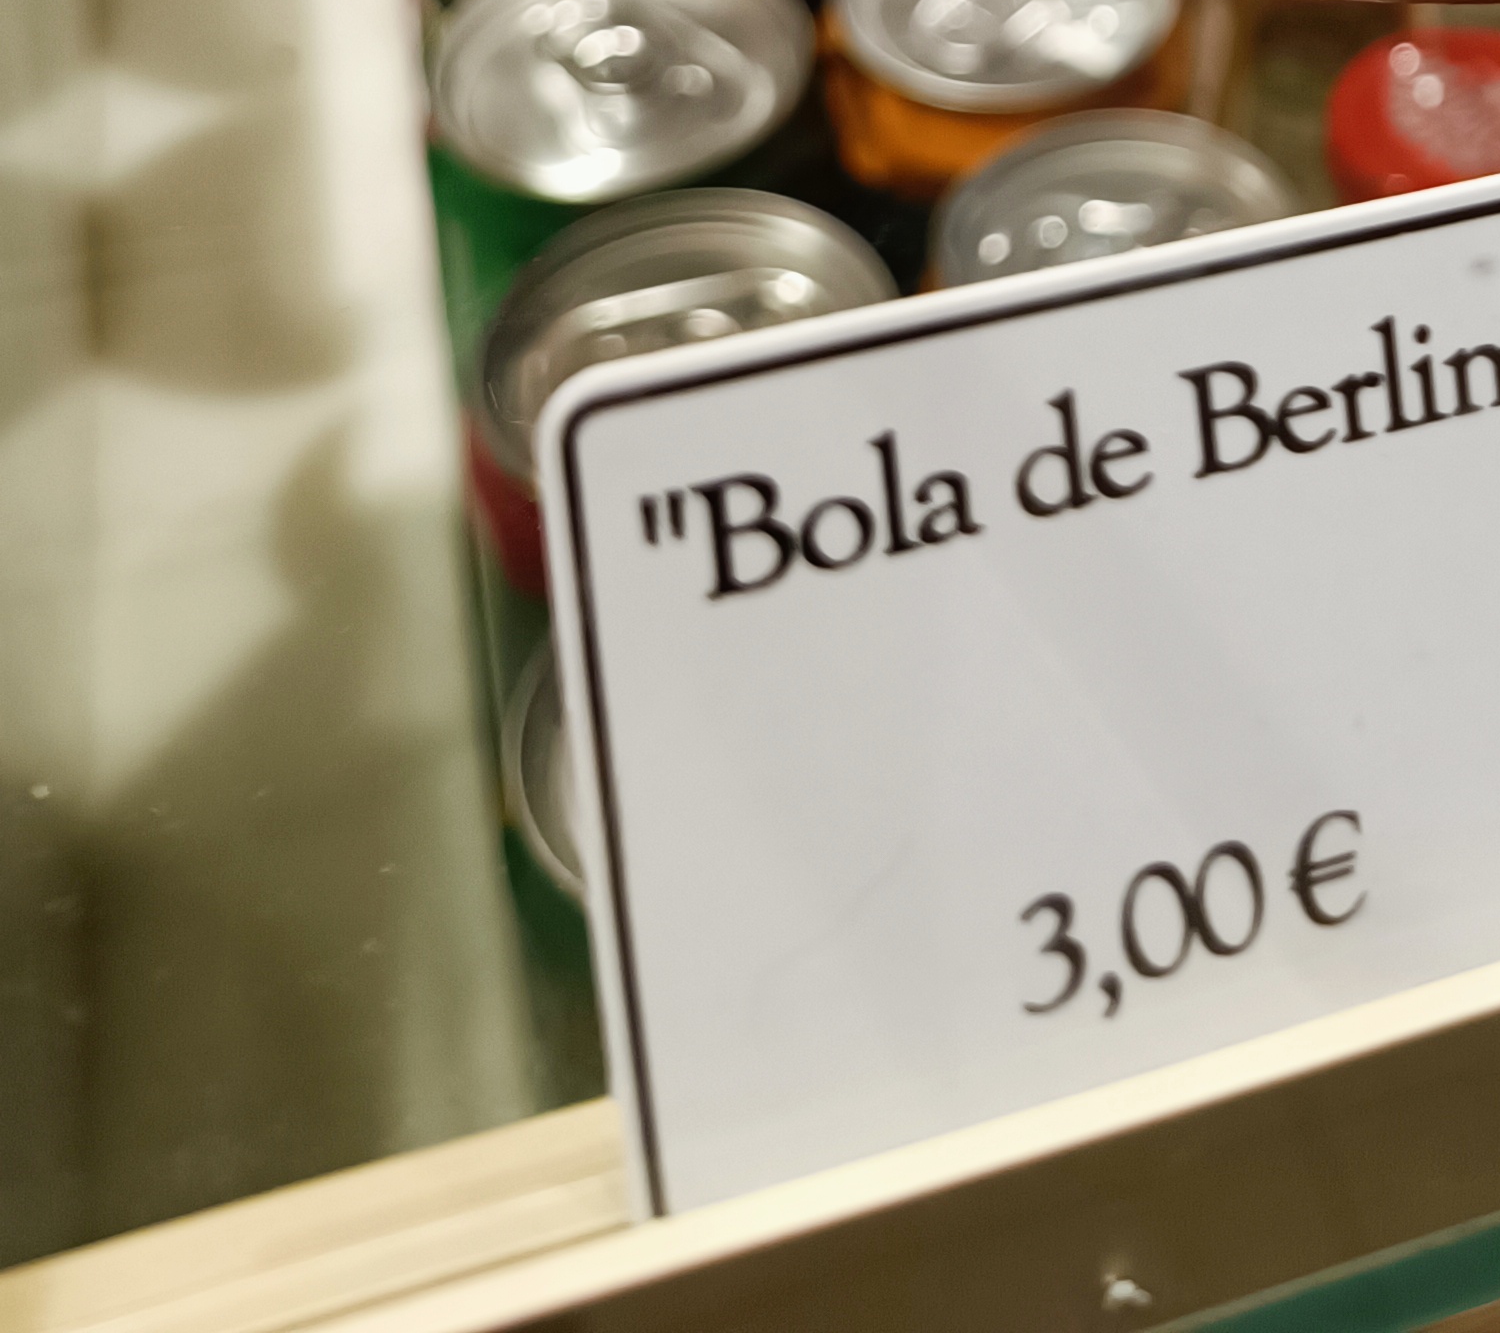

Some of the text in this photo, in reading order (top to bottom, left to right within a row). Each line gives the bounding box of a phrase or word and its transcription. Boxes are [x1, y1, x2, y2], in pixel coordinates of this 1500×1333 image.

[636, 428, 984, 603] "Bola
[1013, 389, 1153, 520] de
[1018, 808, 1368, 1019] 3,00 €
